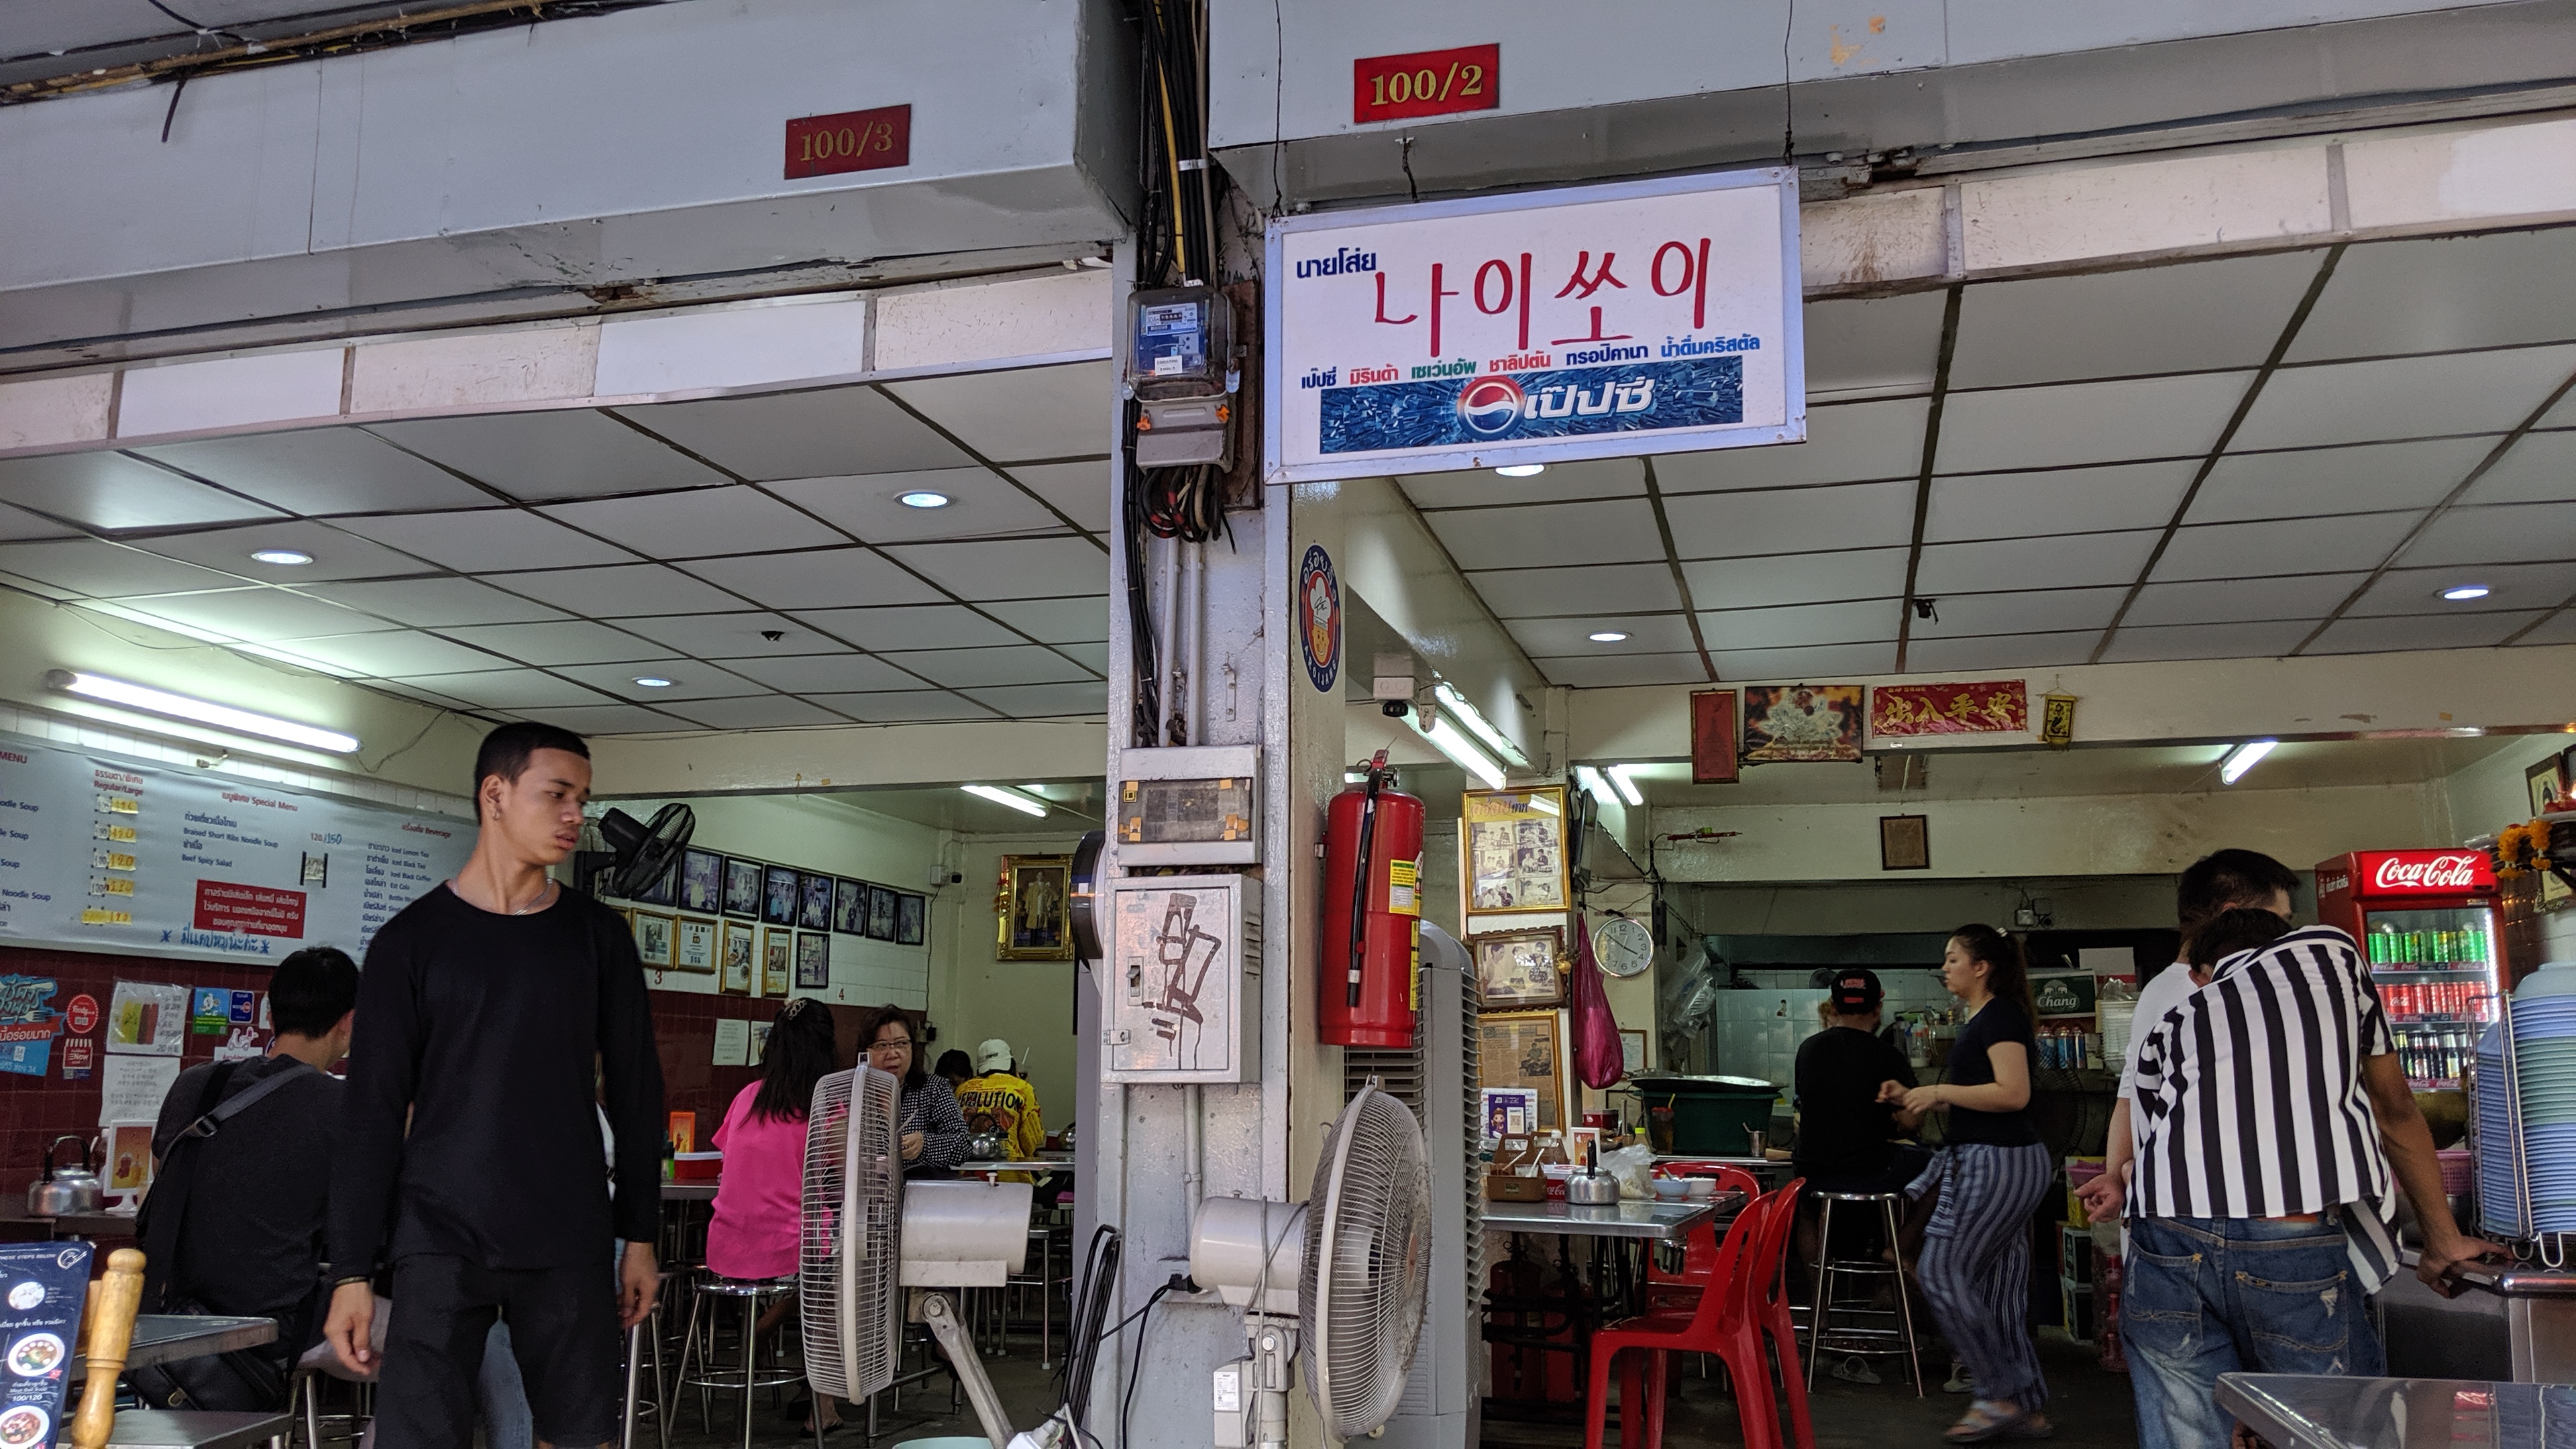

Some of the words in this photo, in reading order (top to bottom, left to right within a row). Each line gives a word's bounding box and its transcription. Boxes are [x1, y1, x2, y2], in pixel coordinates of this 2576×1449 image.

[1371, 62, 1482, 105] 100/2
[799, 121, 893, 161] 100/3
[1296, 248, 1376, 278] นายโส่ย
[1375, 237, 1711, 358] 나이쏘이
[1301, 366, 1337, 389] เป๊ปซี่
[1349, 363, 1399, 385] มิรินด้า
[1411, 358, 1476, 380] เซเว่นอัพ
[1489, 351, 1551, 372] ชาลิปตัน
[1566, 343, 1648, 366] ทรอปิคานา
[1660, 334, 1760, 357] น้ำดื่มคริสตัล
[1885, 693, 2017, 728] 出入平安
[94, 781, 144, 796] Regular/Large
[19, 801, 39, 813] Soup
[252, 796, 276, 808] Special
[278, 800, 299, 812] Menu
[9, 830, 30, 841] Soup
[183, 827, 207, 837] Braised
[208, 830, 224, 839] Short
[240, 835, 262, 845] Noodle
[263, 838, 279, 849] Soup
[425, 826, 451, 839] Beverage
[1, 859, 20, 870] Soup
[182, 853, 196, 863] Beef
[215, 858, 233, 867] Salad
[2375, 855, 2478, 888] Coca-Cola
[3, 889, 29, 898] Noodle
[32, 892, 52, 902] Soup
[653, 970, 663, 985] 3
[838, 988, 845, 1000] 4
[2037, 996, 2077, 1008] Chang
[12, 1394, 42, 1402] 100/120
